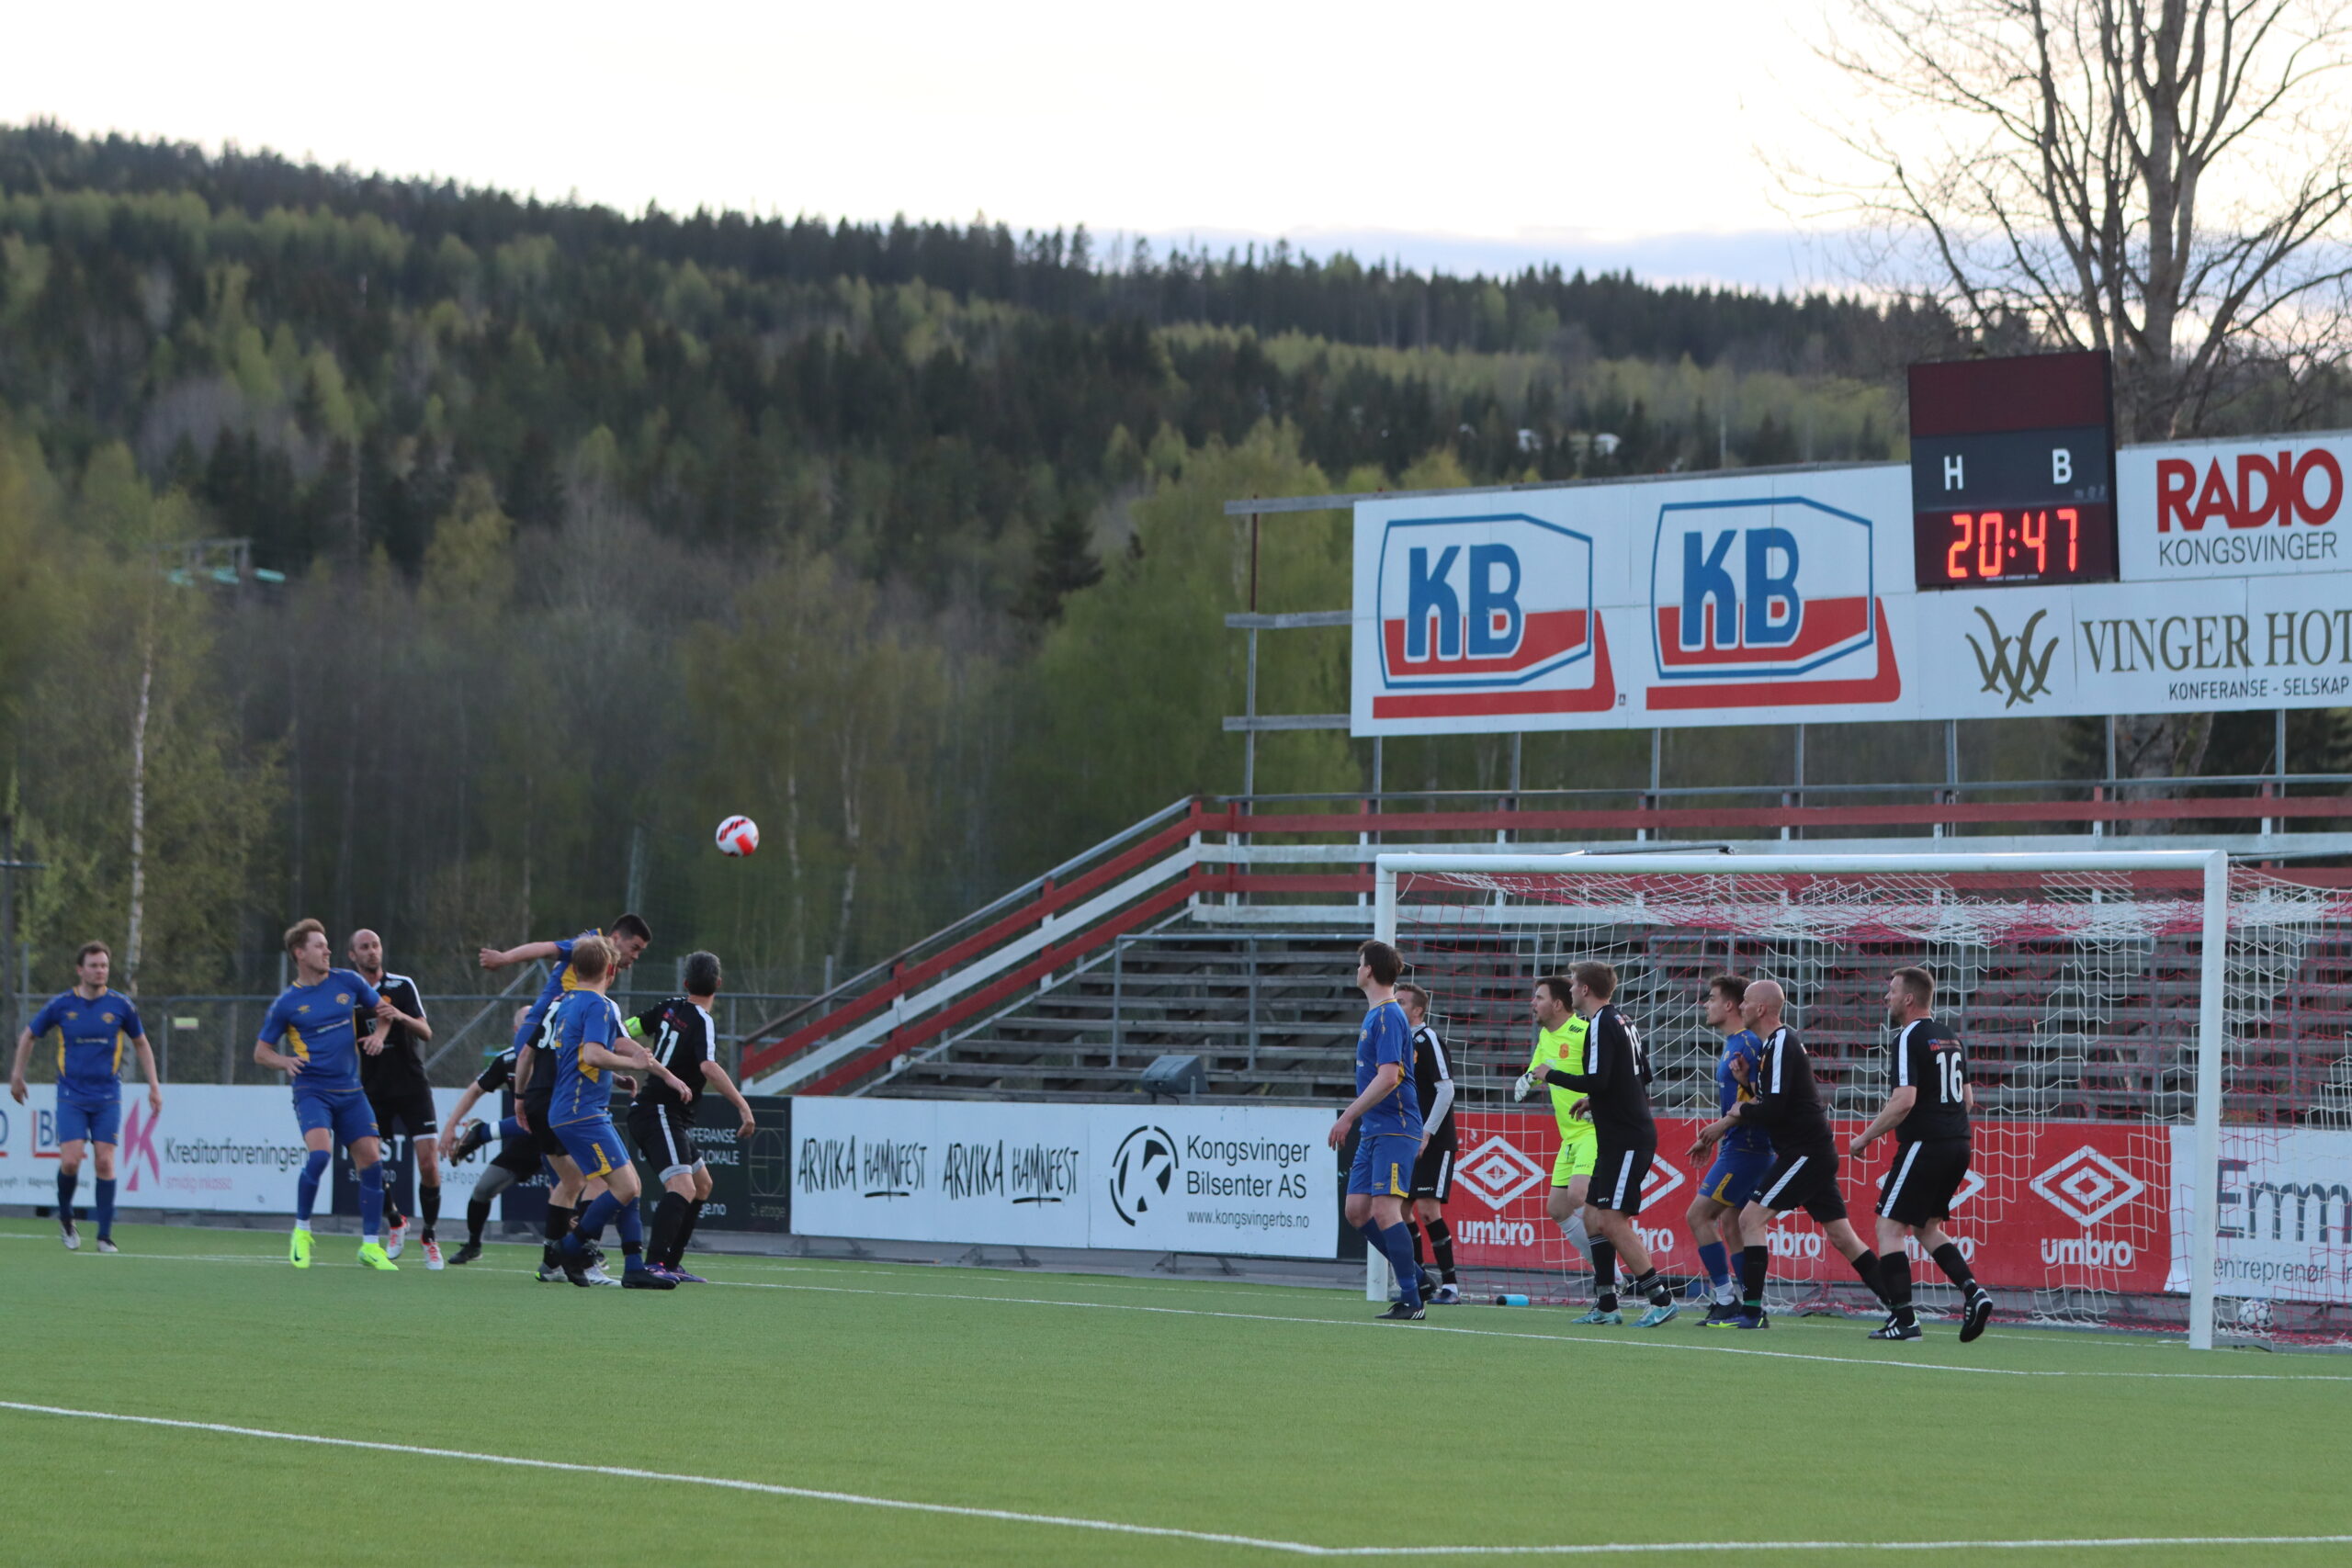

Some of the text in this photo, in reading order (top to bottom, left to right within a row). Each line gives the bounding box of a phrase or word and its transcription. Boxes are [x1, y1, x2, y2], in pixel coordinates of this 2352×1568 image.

[1944, 447, 2072, 491] H B
[2155, 447, 2344, 533] RADIO
[1947, 508, 2078, 579] 20:47
[2158, 531, 2338, 567] KONGSVINGER
[1407, 542, 1521, 659] KB
[1682, 527, 1800, 647] KB
[2080, 609, 2352, 673] VINGER HOT
[2168, 678, 2268, 701] KONFERANSE
[2283, 675, 2349, 697] SELSKAP
[653, 1020, 680, 1067] 11
[1936, 1052, 1963, 1103] 16
[164, 1137, 310, 1172] Kreditorforeningen
[797, 1134, 928, 1201] ARVIKA HAMNFEST
[1187, 1134, 1311, 1168] Kongsvinger
[942, 1139, 1080, 1208] ARVIKA HAMNFEST
[1187, 1170, 1307, 1199] Bilsenter AS
[1187, 1208, 1310, 1231] www.kongsvingerbs.no
[1457, 1214, 1534, 1247] umbro
[1630, 1219, 1674, 1253] bro
[1765, 1224, 1821, 1258] mbro
[2041, 1232, 2132, 1267] umbro
[2213, 1258, 2328, 1286] entreprenør
